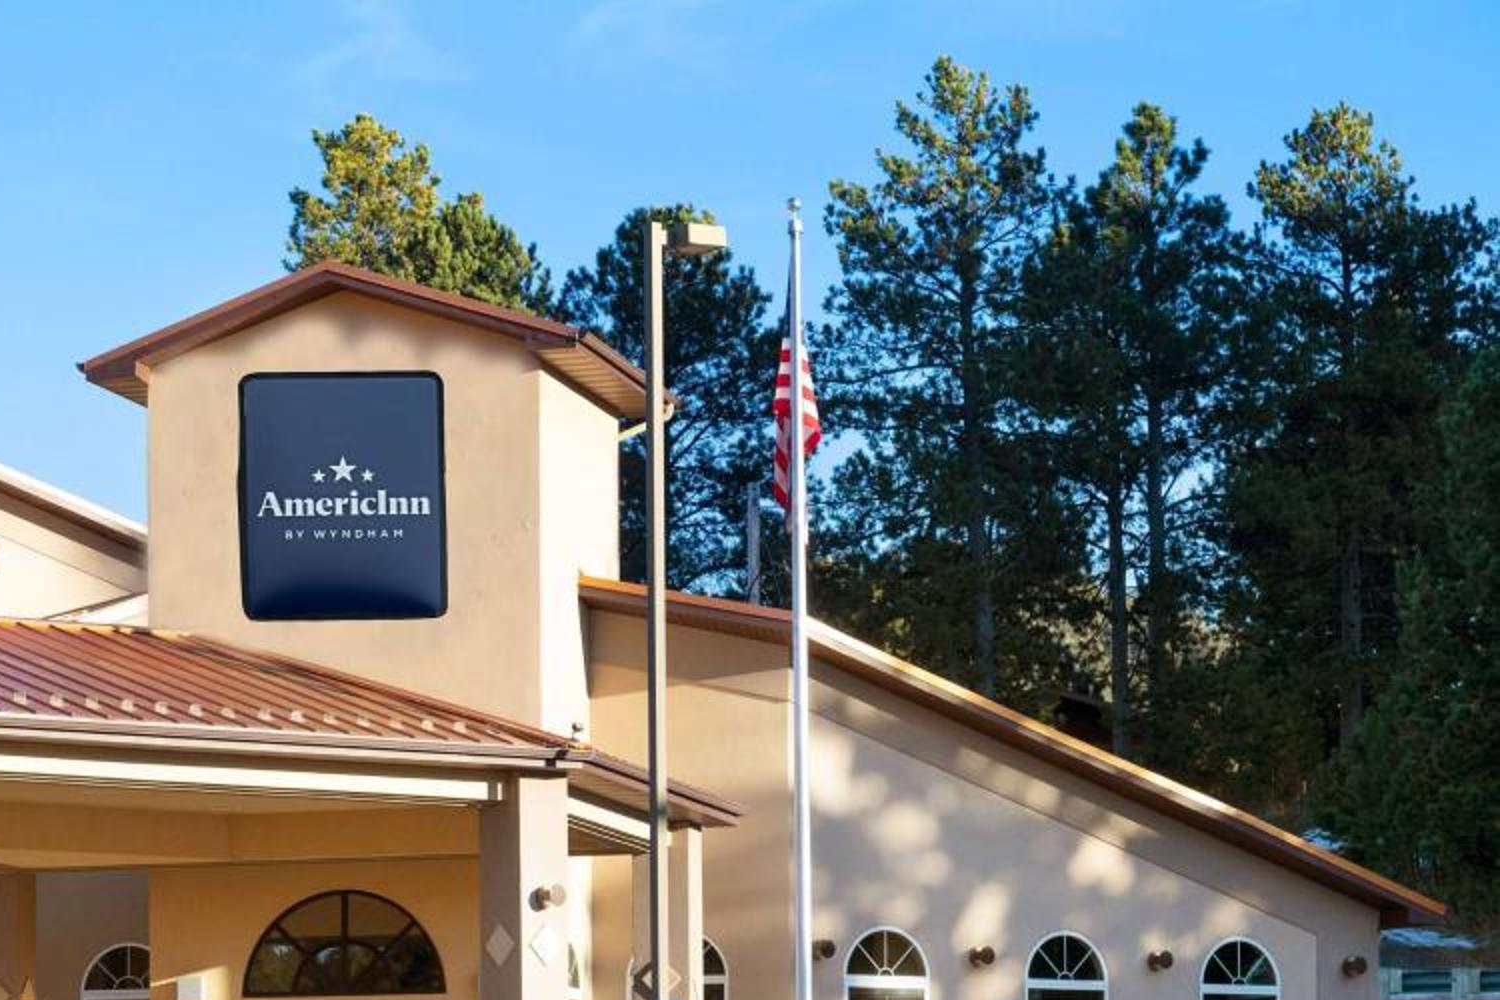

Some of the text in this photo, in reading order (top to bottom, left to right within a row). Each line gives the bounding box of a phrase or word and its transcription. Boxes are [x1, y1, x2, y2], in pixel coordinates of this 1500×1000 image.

[257, 489, 431, 517] AmericInn
[285, 529, 404, 540] BY WYNDHAM
